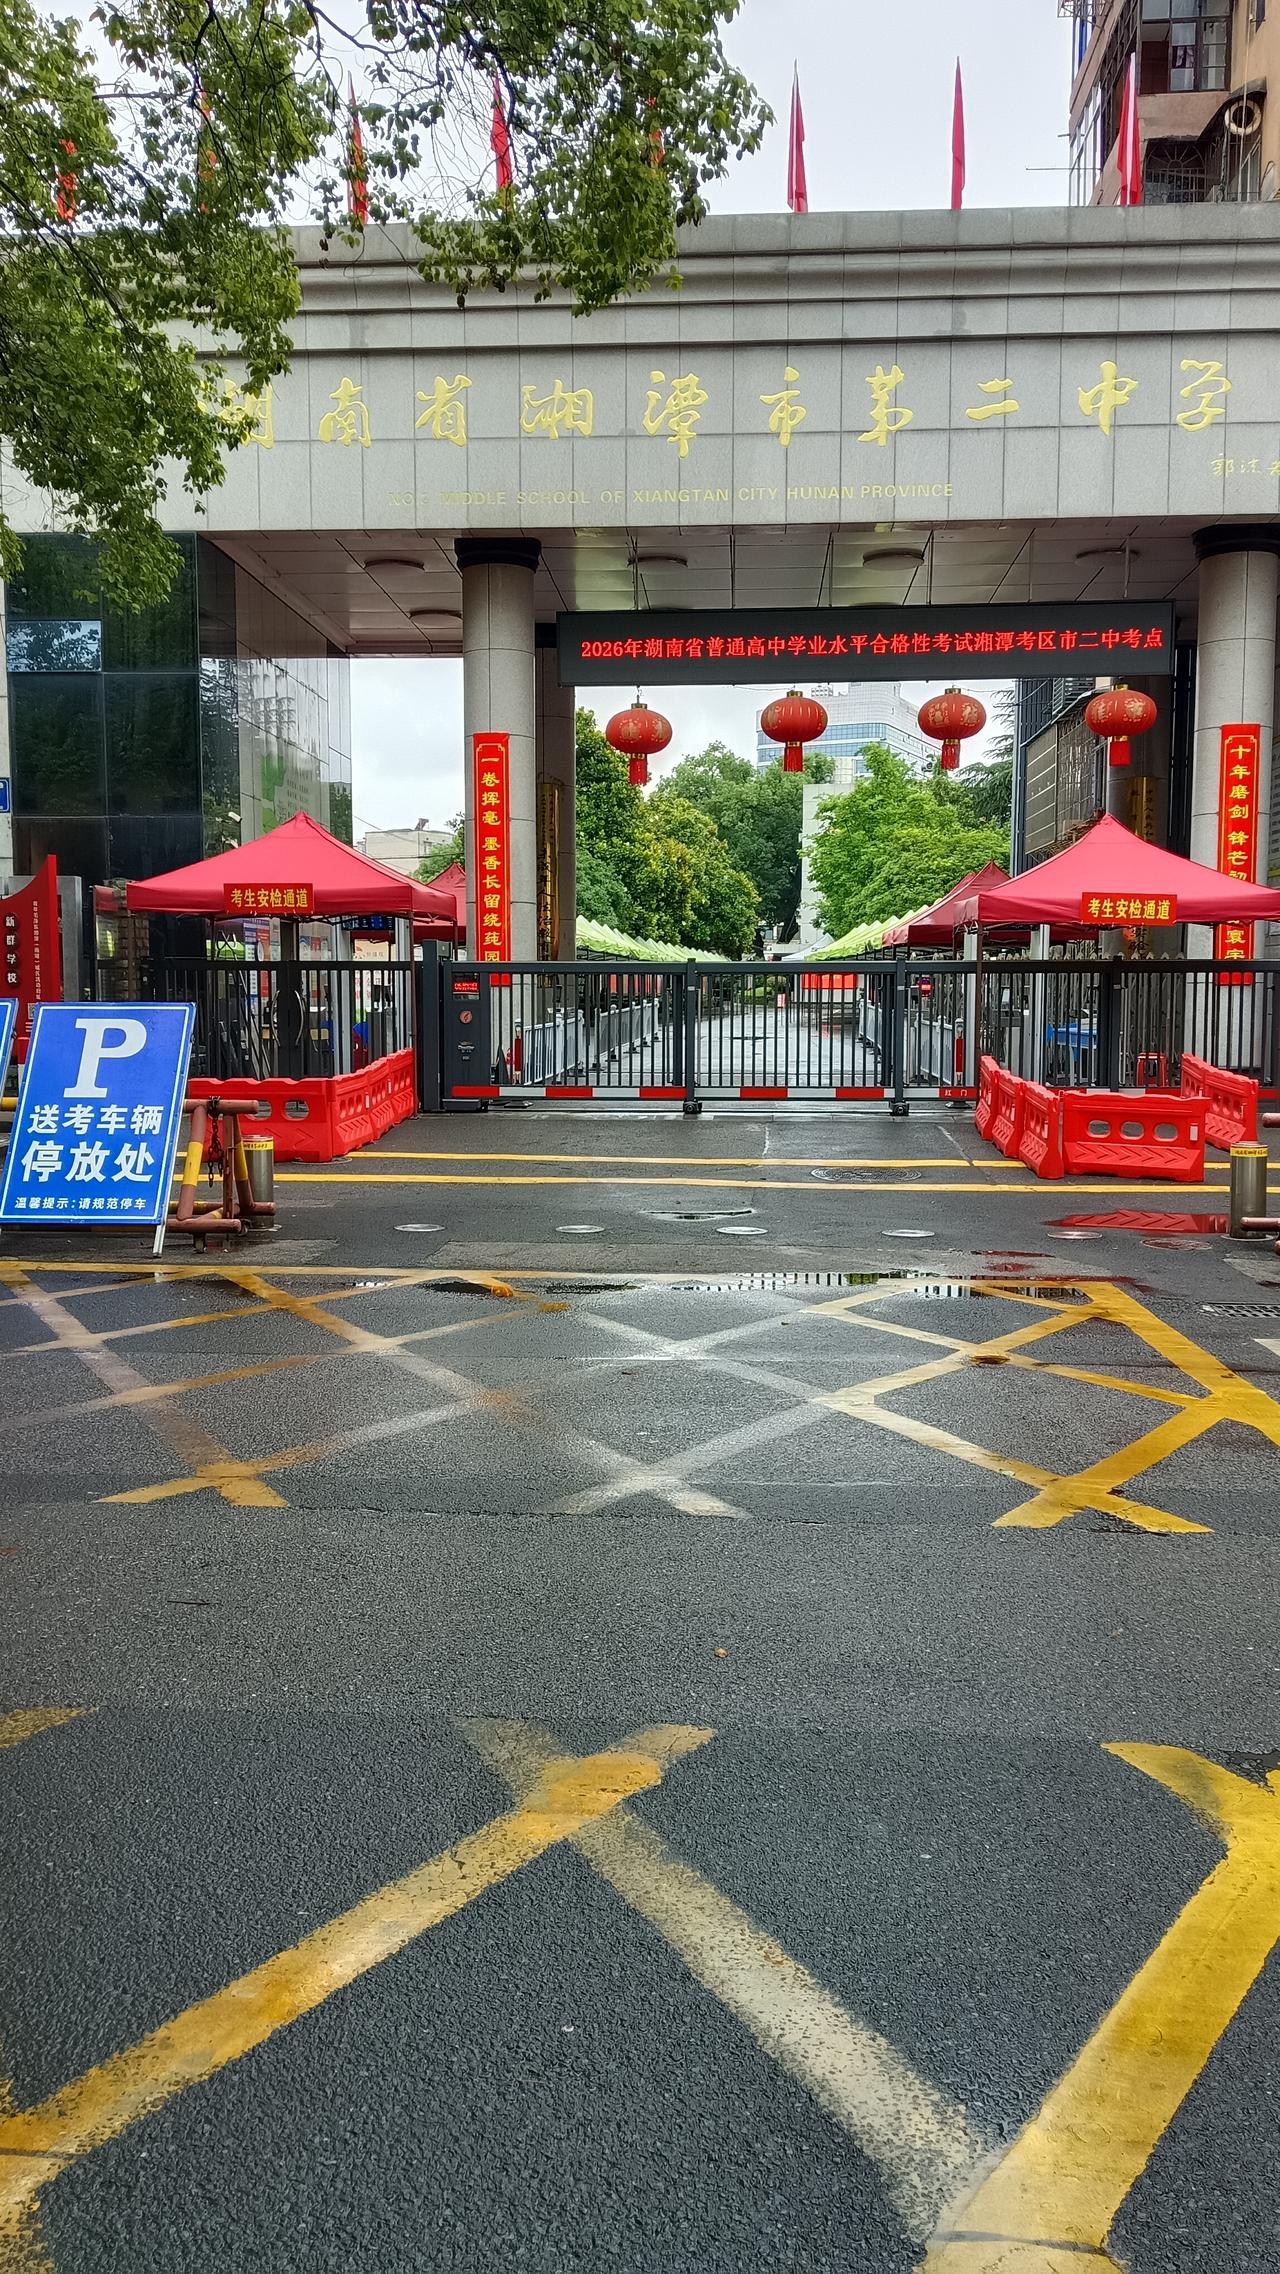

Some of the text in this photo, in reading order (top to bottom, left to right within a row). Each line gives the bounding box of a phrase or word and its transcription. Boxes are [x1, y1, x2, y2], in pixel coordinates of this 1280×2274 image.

[516, 489, 589, 504] SCHOOL
[600, 489, 624, 503] OF
[633, 488, 729, 502] XIANGTAN
[738, 487, 778, 501] CITY
[787, 486, 854, 500] HUNAN
[861, 483, 953, 498] PROVINCE
[580, 627, 1164, 658] 2026年湖南省普通高中学业水平合格性考试湘潭考区市二中考点
[230, 887, 308, 908] 考生安检通道
[1087, 897, 1171, 920] 考生安检通道
[62, 1018, 147, 1098] P
[27, 1103, 164, 1135] 送考车辆
[21, 1140, 155, 1182] 停放处
